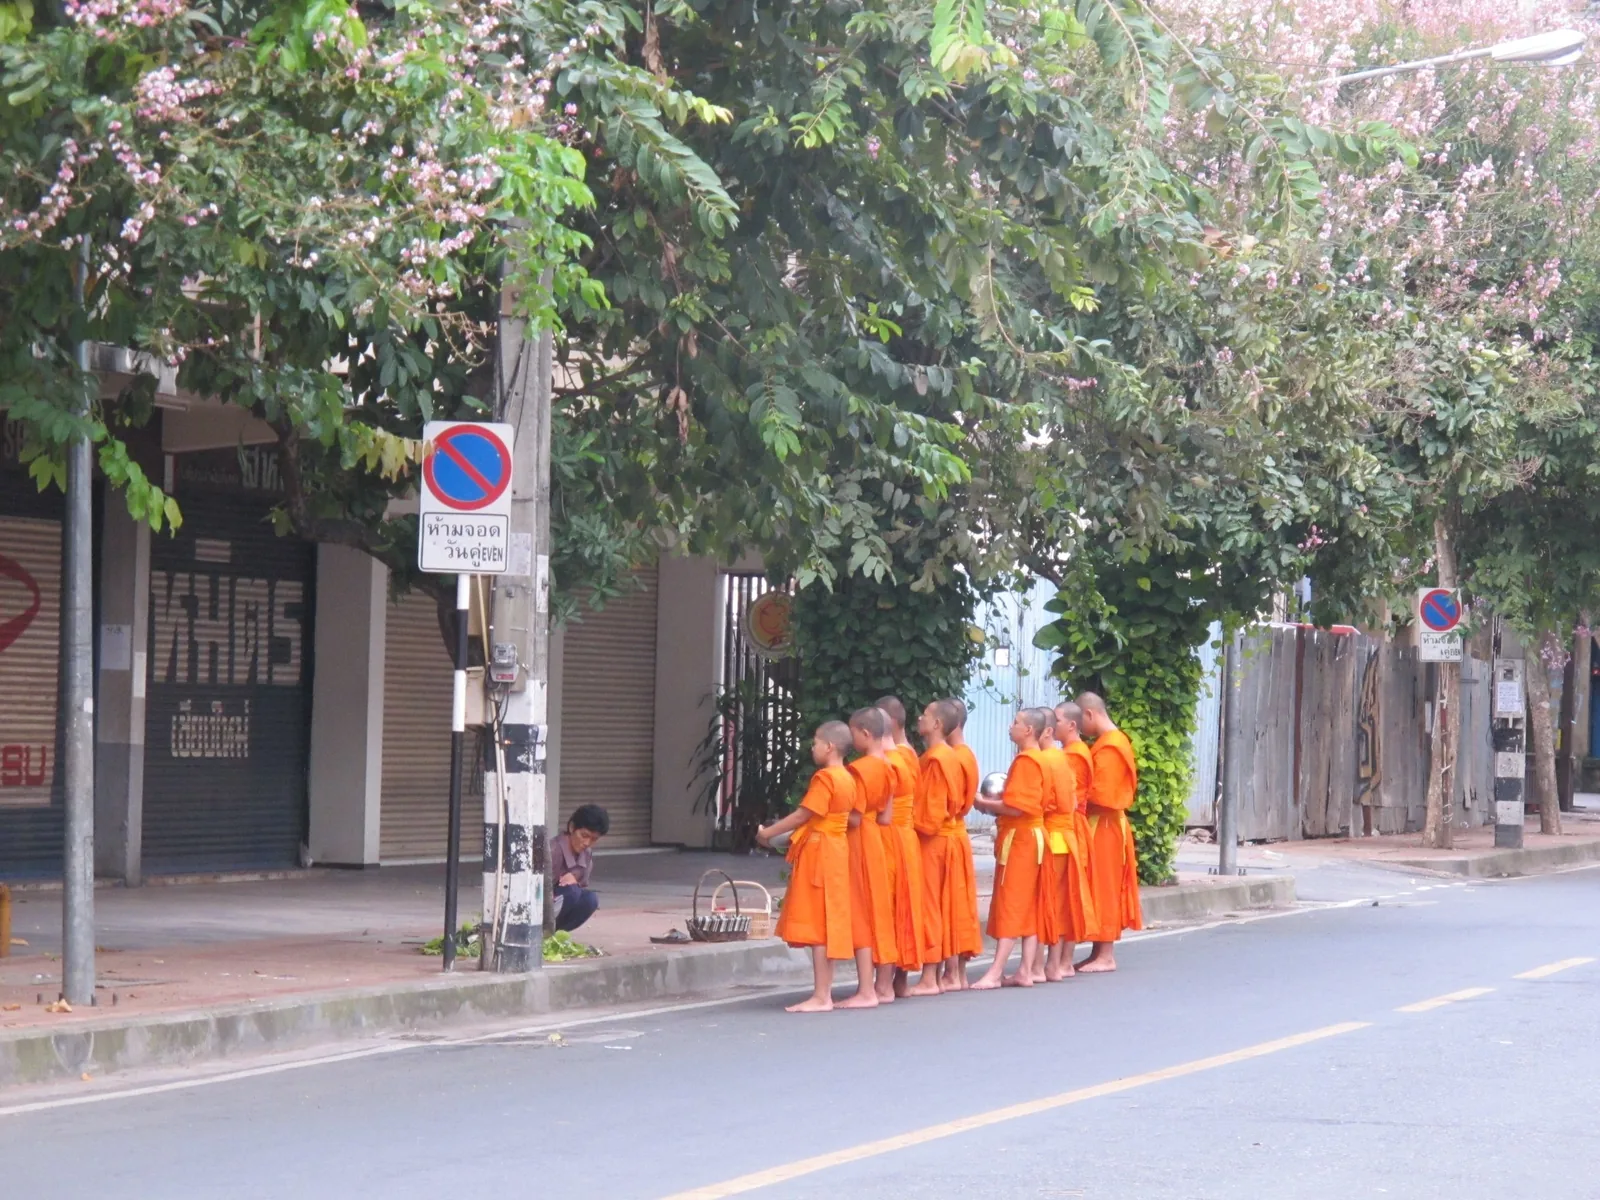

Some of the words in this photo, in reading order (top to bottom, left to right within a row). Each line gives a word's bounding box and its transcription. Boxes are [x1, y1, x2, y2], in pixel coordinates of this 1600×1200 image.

[426, 515, 501, 537] ห้ามจอด
[444, 539, 481, 567] วันคู่
[481, 547, 504, 562] EVEN
